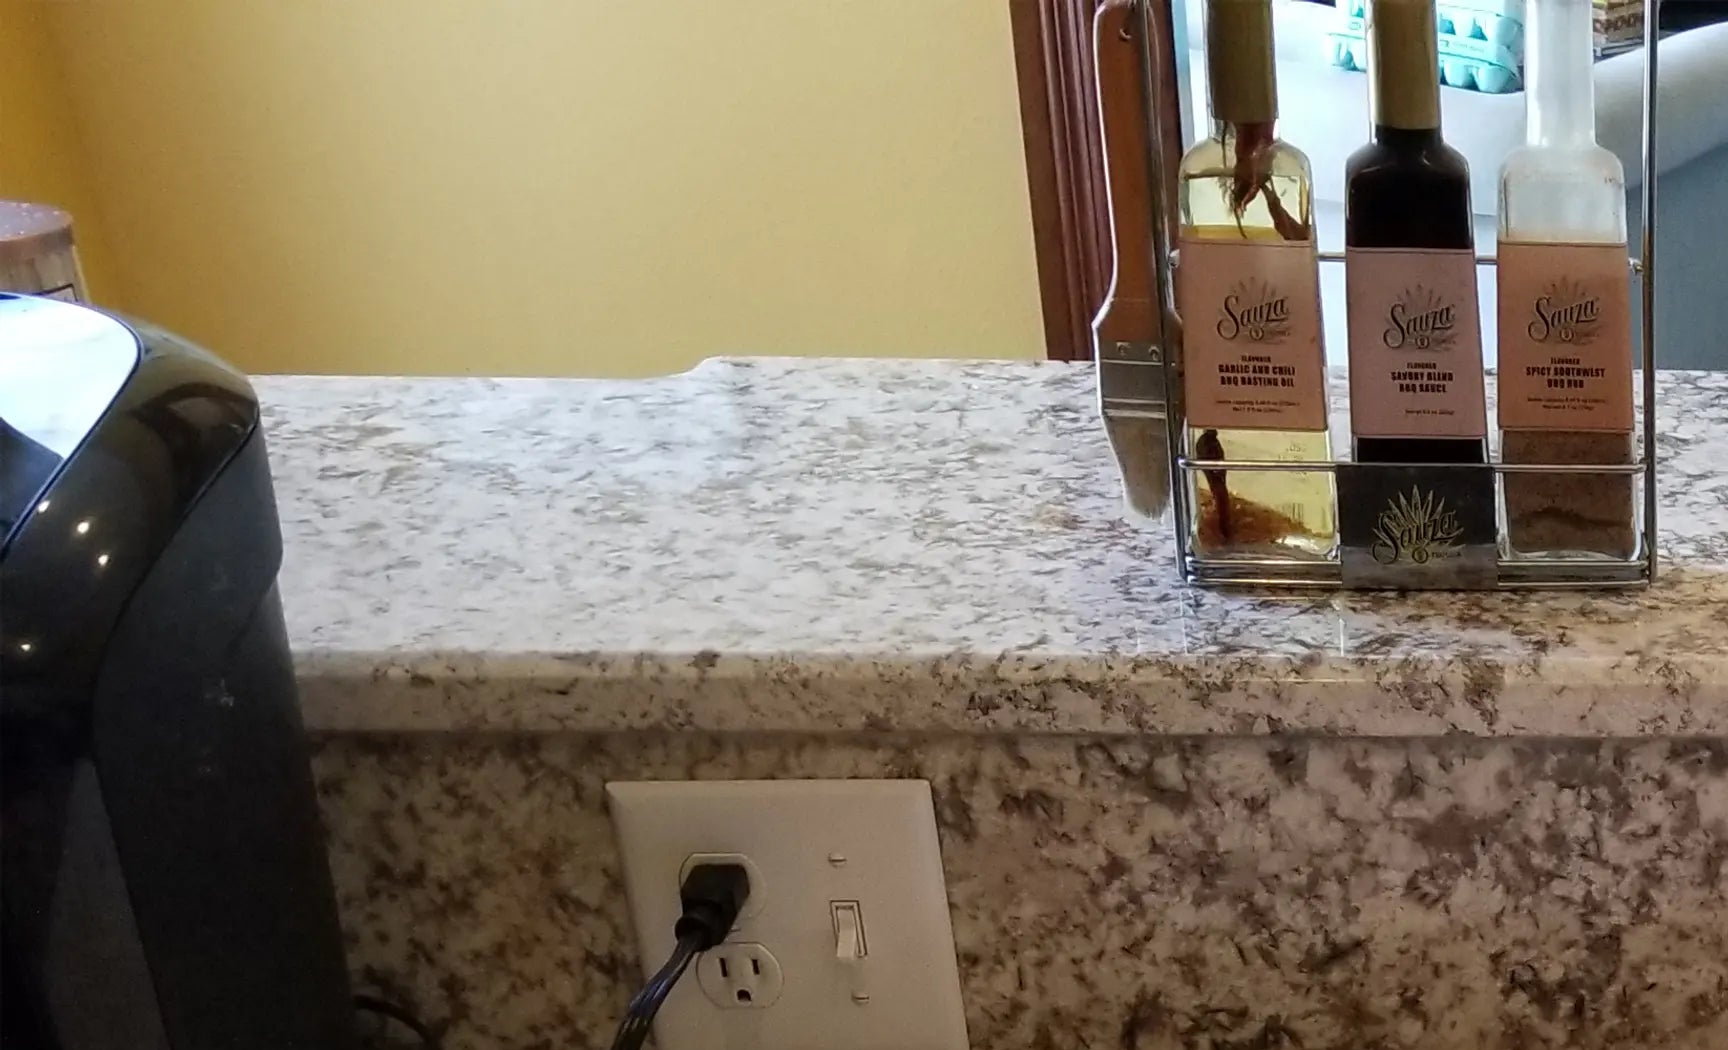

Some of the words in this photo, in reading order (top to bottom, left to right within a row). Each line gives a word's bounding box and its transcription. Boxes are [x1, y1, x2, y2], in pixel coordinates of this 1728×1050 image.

[1217, 295, 1288, 340] Sauza
[1527, 297, 1598, 342] Sauza
[1383, 303, 1454, 349] Sauza
[1218, 364, 1250, 374] GARLIC
[1252, 365, 1270, 374] AND
[1272, 366, 1296, 376] CHILI
[1391, 371, 1424, 381] SAVORY
[1526, 366, 1551, 376] SPICY
[1553, 367, 1606, 378] SOUTHWEST
[1241, 377, 1278, 387] BASTING
[1281, 377, 1295, 387] OIL
[1418, 384, 1447, 393] SAUCE
